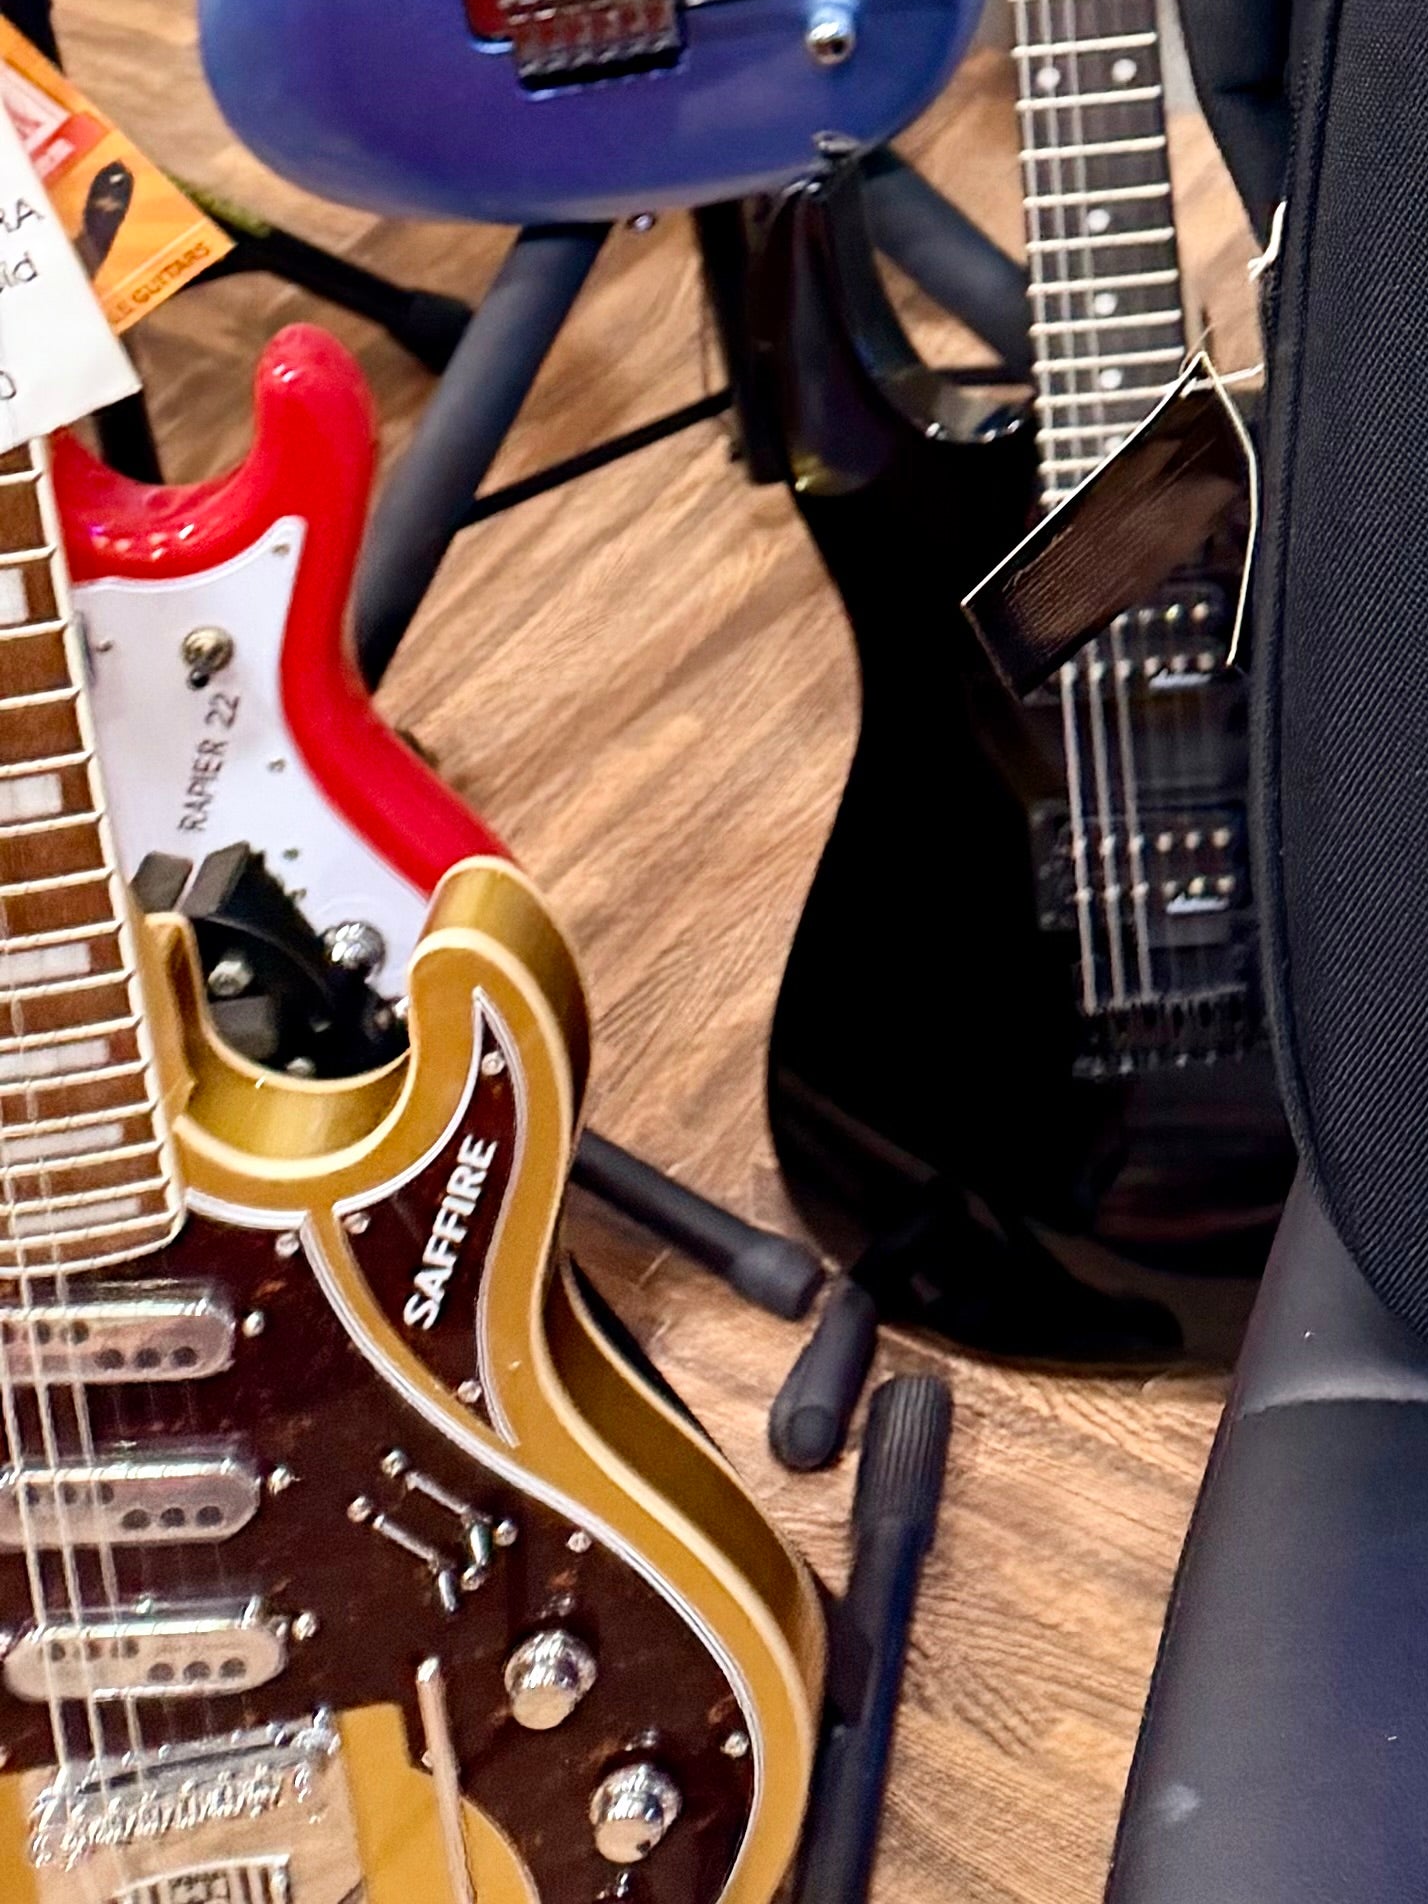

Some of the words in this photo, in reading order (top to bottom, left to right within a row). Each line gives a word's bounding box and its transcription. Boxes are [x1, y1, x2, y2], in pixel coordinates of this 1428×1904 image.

[177, 737, 227, 833] RAPIER
[205, 693, 240, 729] 22
[403, 1134, 498, 1329] SAFFIRE
